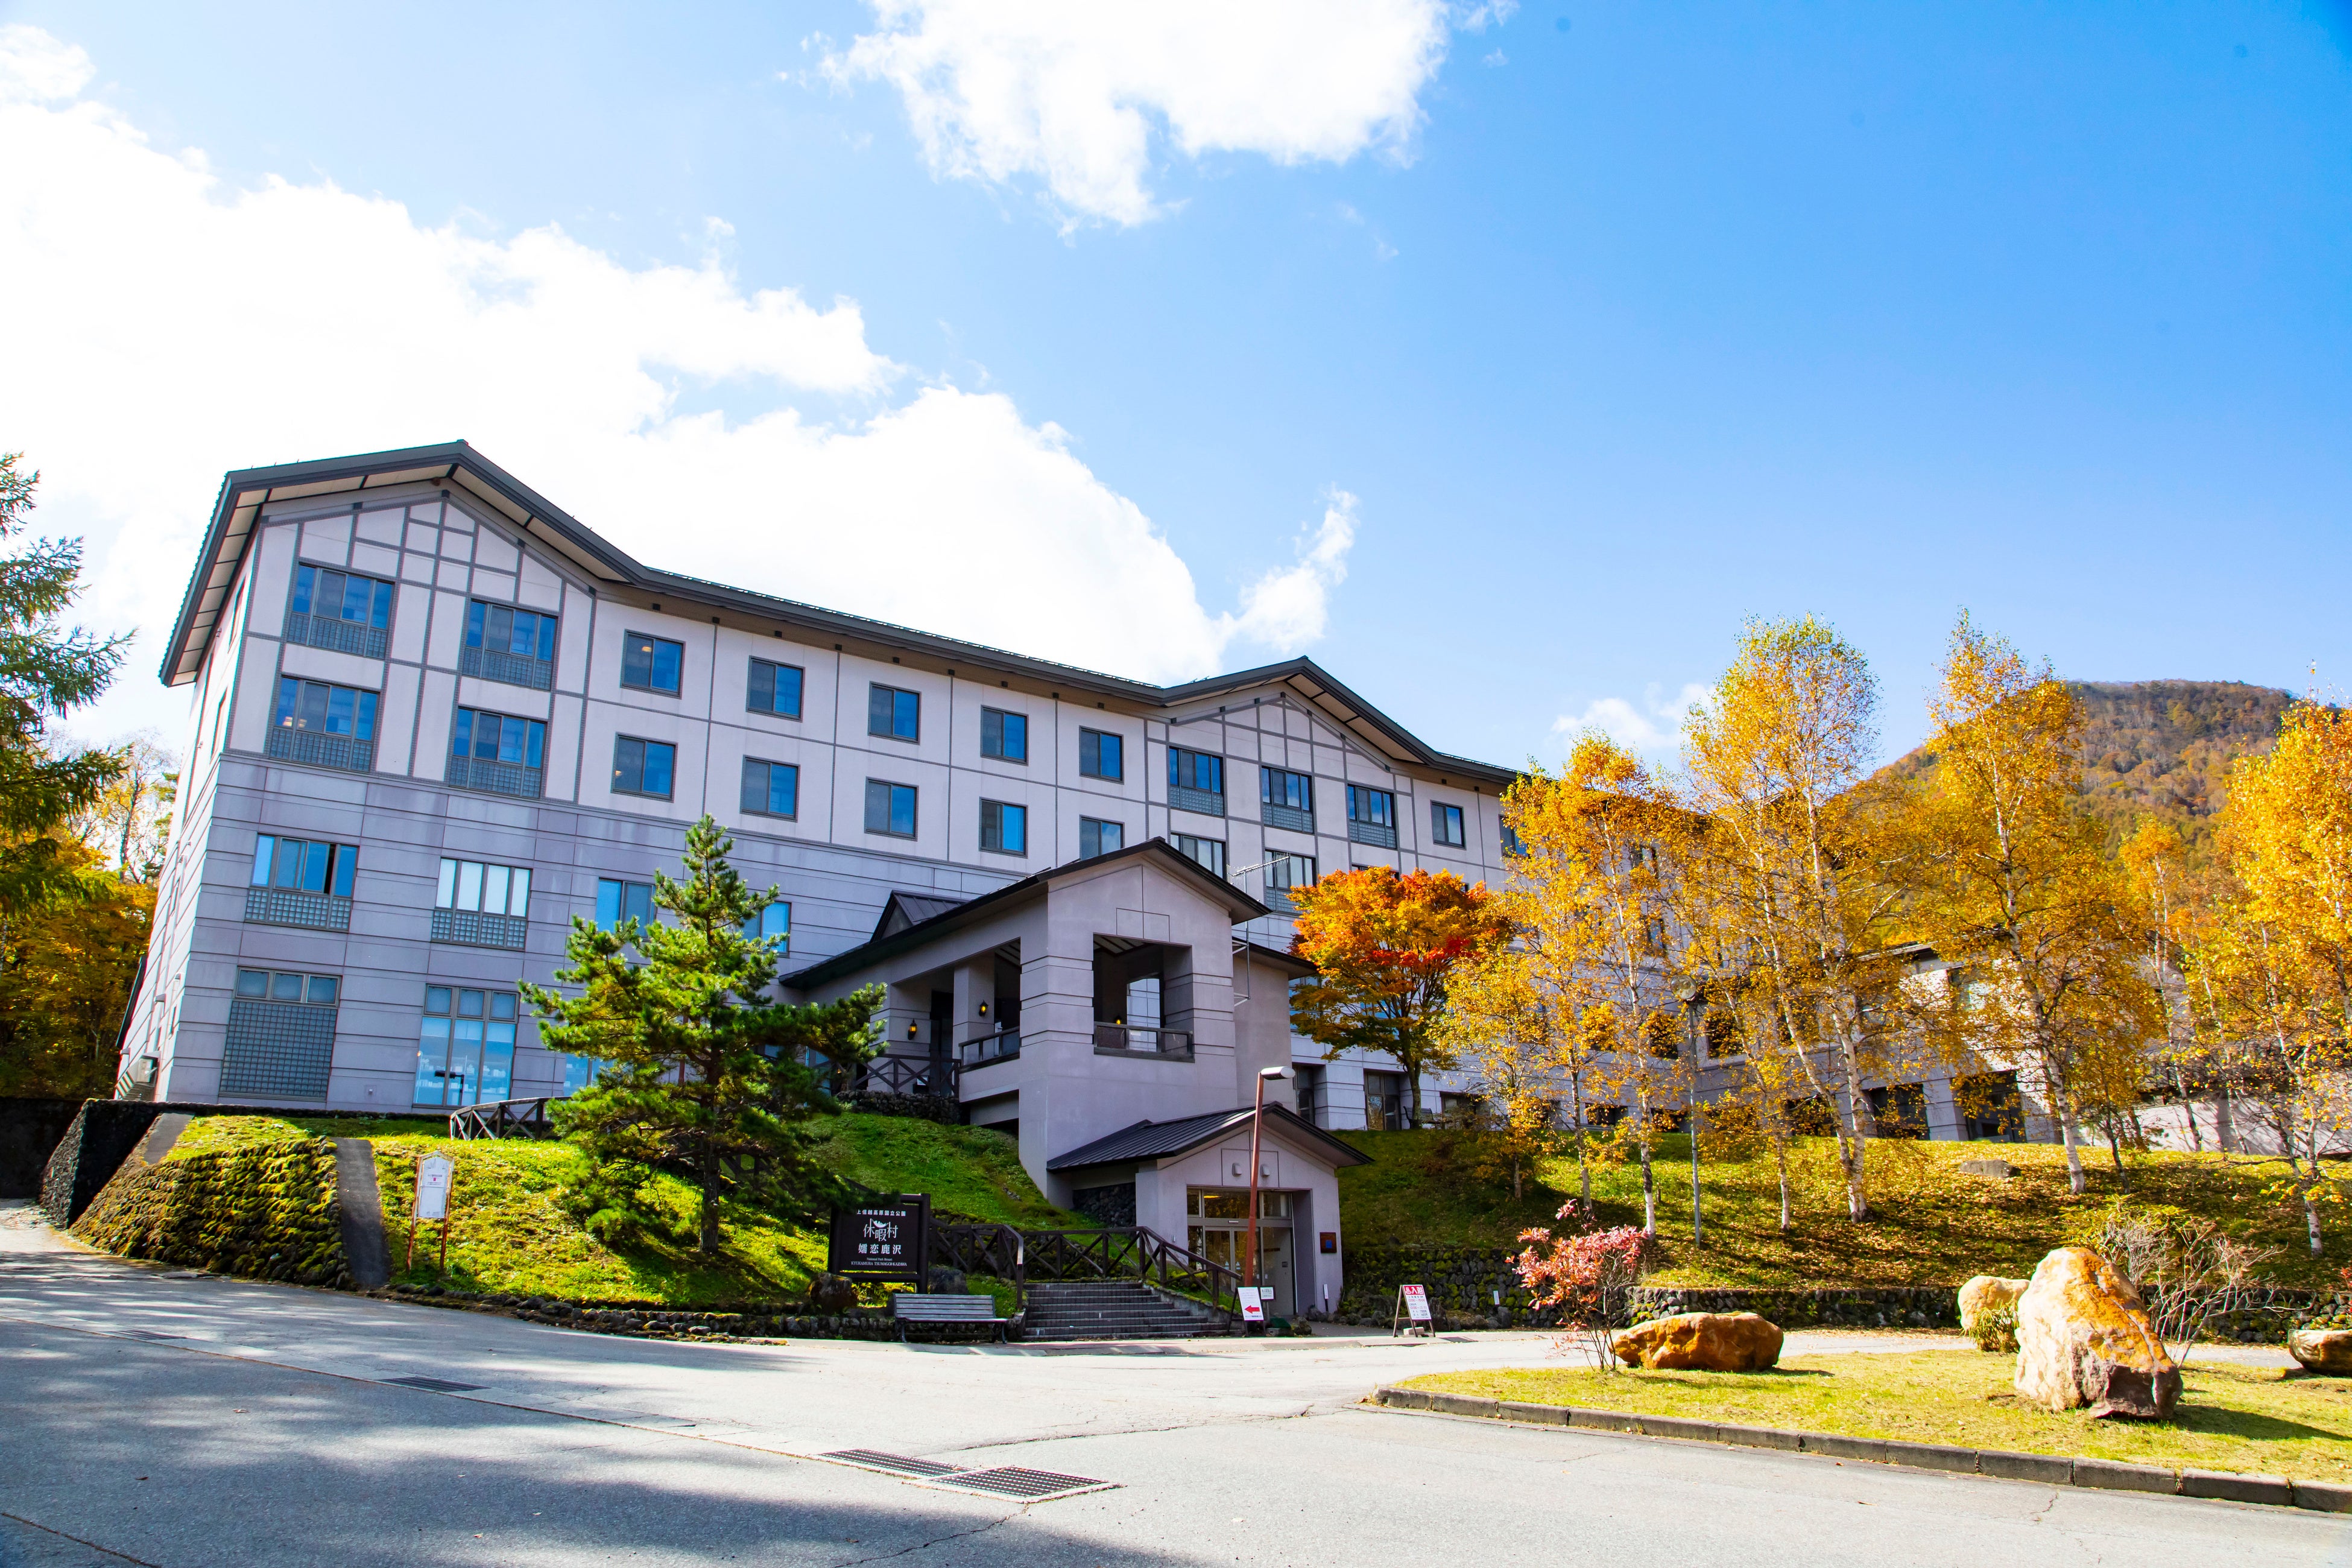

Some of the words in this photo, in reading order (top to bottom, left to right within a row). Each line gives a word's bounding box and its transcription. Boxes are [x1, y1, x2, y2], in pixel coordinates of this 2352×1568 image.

[863, 1218, 899, 1242] 休暇村
[858, 1243, 902, 1254] 嬬恋鹿沢
